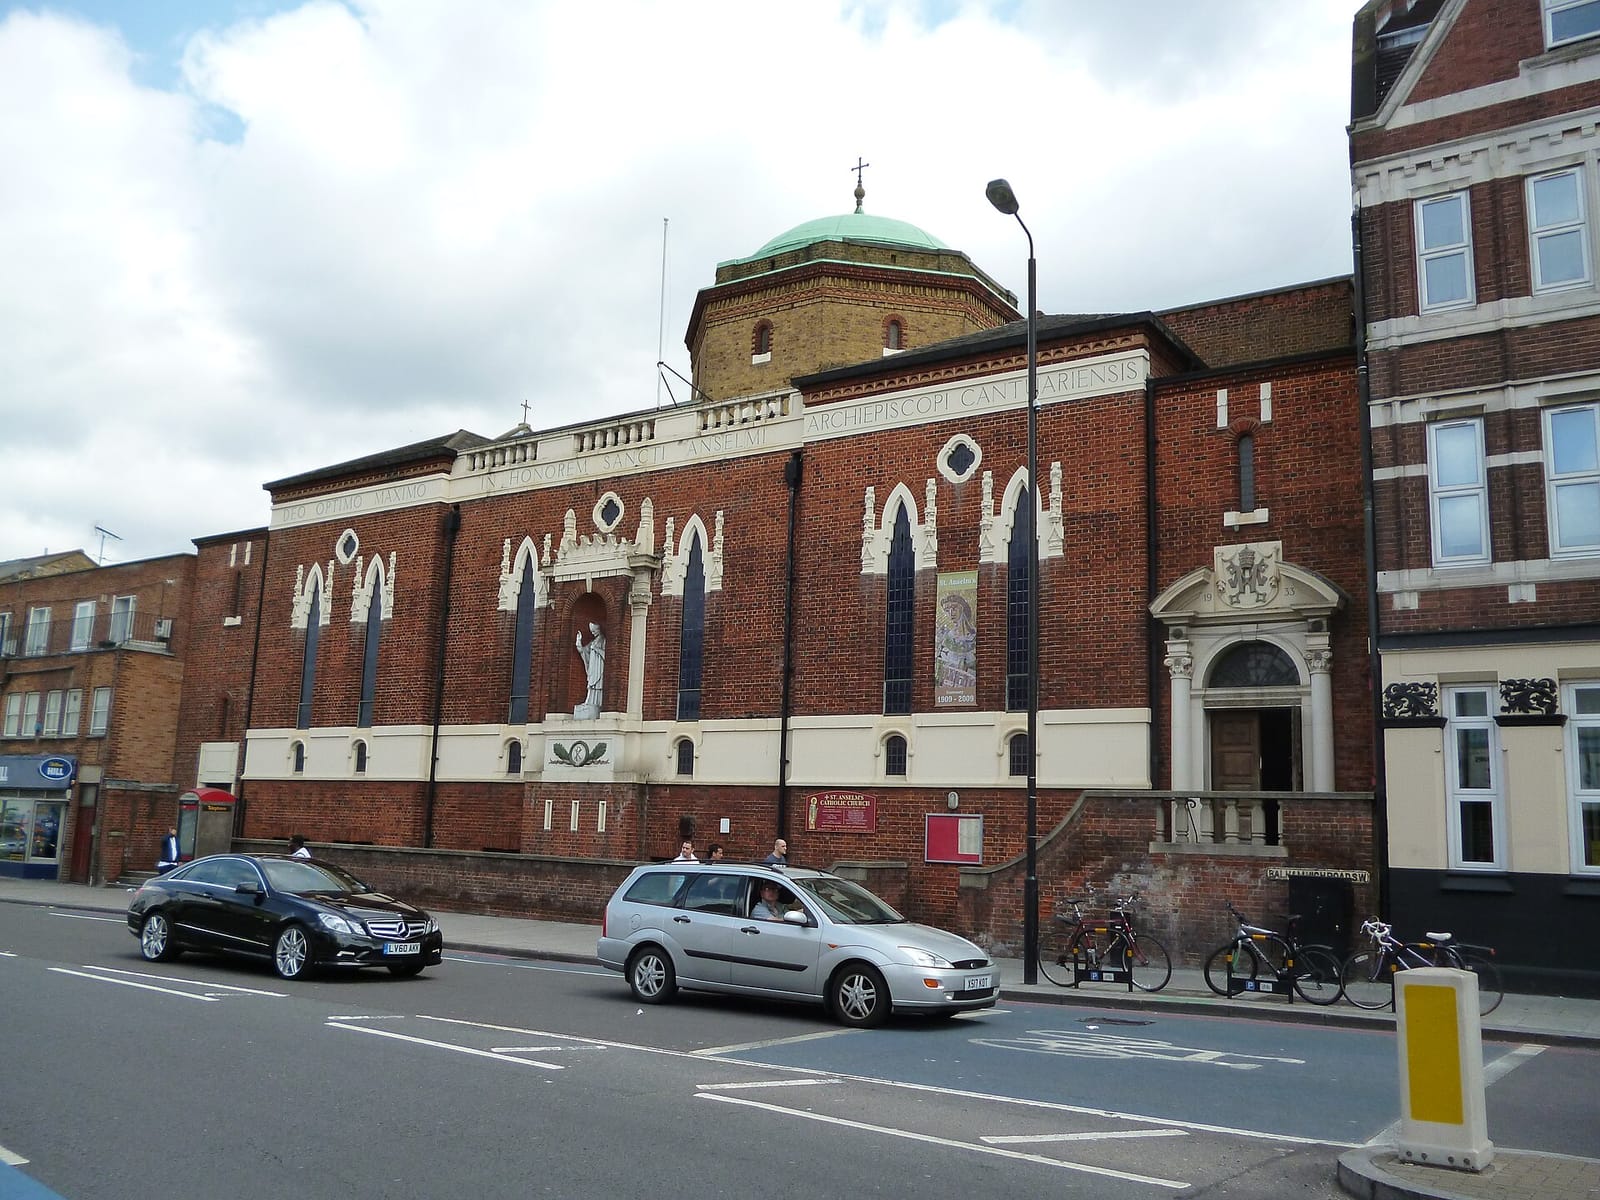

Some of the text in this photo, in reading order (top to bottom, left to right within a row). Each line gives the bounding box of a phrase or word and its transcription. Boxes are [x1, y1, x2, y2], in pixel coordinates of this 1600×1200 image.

[807, 393, 949, 433] ARCHIEPISCOPI
[480, 428, 767, 490] IN HONOREM SANCTI ANSELMI
[282, 483, 427, 522] DEO OPTIMO MAXIMO
[1203, 593, 1212, 602] 19
[1284, 587, 1295, 596] 33
